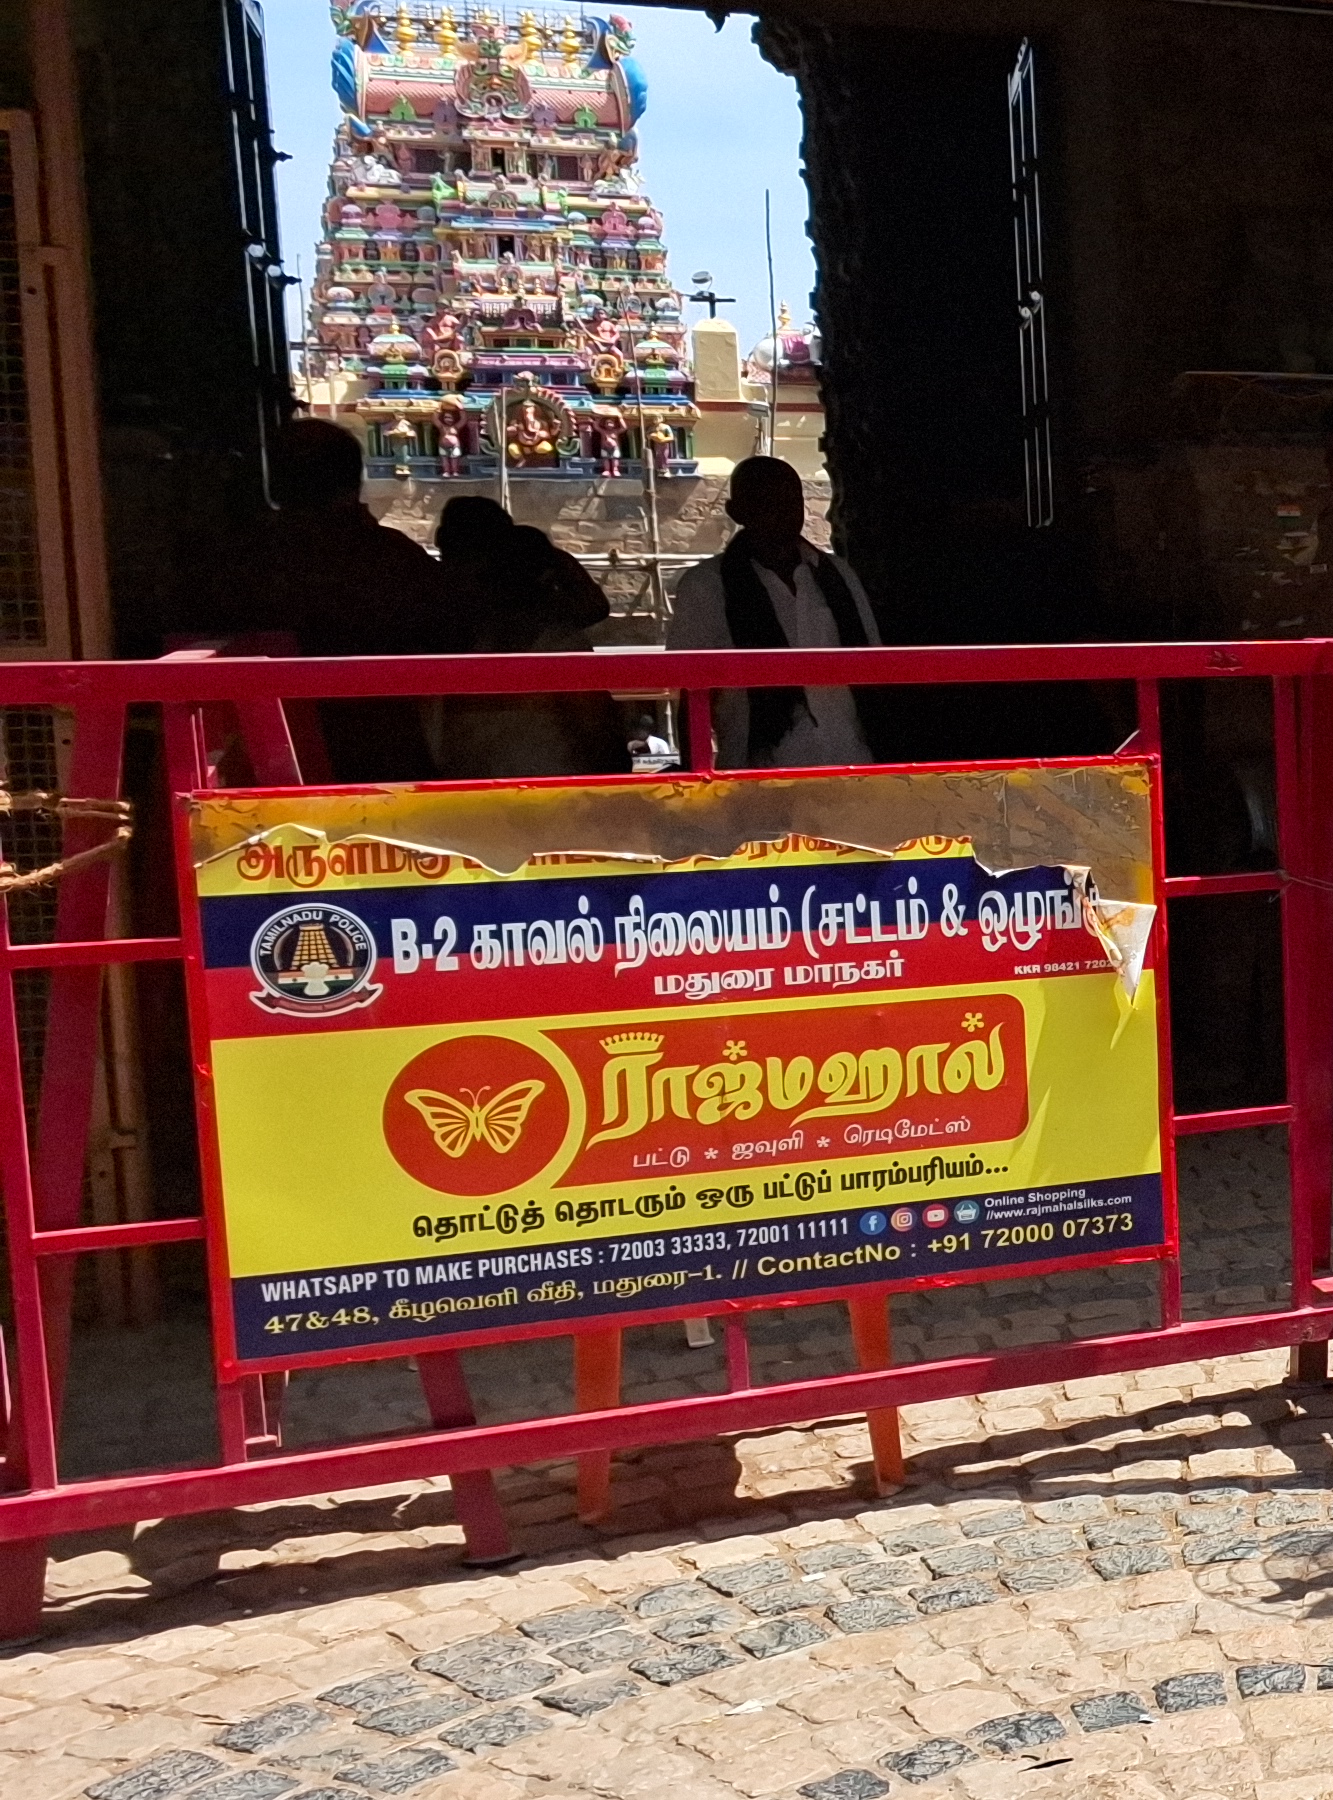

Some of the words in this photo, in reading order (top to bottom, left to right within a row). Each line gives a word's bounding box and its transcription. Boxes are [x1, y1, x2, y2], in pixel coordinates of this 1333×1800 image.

[260, 910, 323, 958] TAMILNADU
[329, 913, 368, 952] POLICE
[390, 915, 461, 975] B-2
[470, 894, 605, 971] காவல்
[615, 883, 791, 979] நிலையம்
[801, 875, 930, 960] (சட்டம்
[940, 882, 969, 939] &
[653, 965, 775, 999] மதுரை
[784, 950, 906, 989] மாநகர்
[1013, 964, 1042, 975] KKR
[585, 1012, 1006, 1152] ராஜ்மஹால்
[632, 1145, 690, 1168] பட்டு
[731, 1130, 805, 1161] ஜவுளி
[843, 1114, 972, 1147] ரெடிமேட்ஸ்
[412, 1200, 546, 1243] தொட்டுத்
[555, 1184, 687, 1228] தொடரும்
[695, 1184, 755, 1210] ஒரு
[762, 1167, 832, 1202] பட்டுப்
[841, 1151, 1010, 1194] பாரம்பரியம்...
[984, 1192, 1024, 1209] Online
[1027, 1186, 1087, 1206] Shopping
[984, 1194, 1133, 1221] //www.rajmahalsilks.com
[261, 1271, 379, 1303] WHATSAPP
[383, 1268, 411, 1289] TO
[415, 1260, 473, 1286] MAKE
[478, 1246, 593, 1278] PURCHASES
[609, 1237, 667, 1263] 72003
[670, 1229, 732, 1258] 33333,
[736, 1224, 791, 1247] 72001
[797, 1216, 850, 1241] 11111
[263, 1305, 380, 1336] 47&48,
[388, 1285, 519, 1324] கீழவெளி
[527, 1278, 585, 1304] வீதி,
[756, 1239, 902, 1277] ContactNo
[927, 1230, 972, 1255] +91
[981, 1221, 1055, 1250] 72000
[1062, 1212, 1134, 1241] 07373
